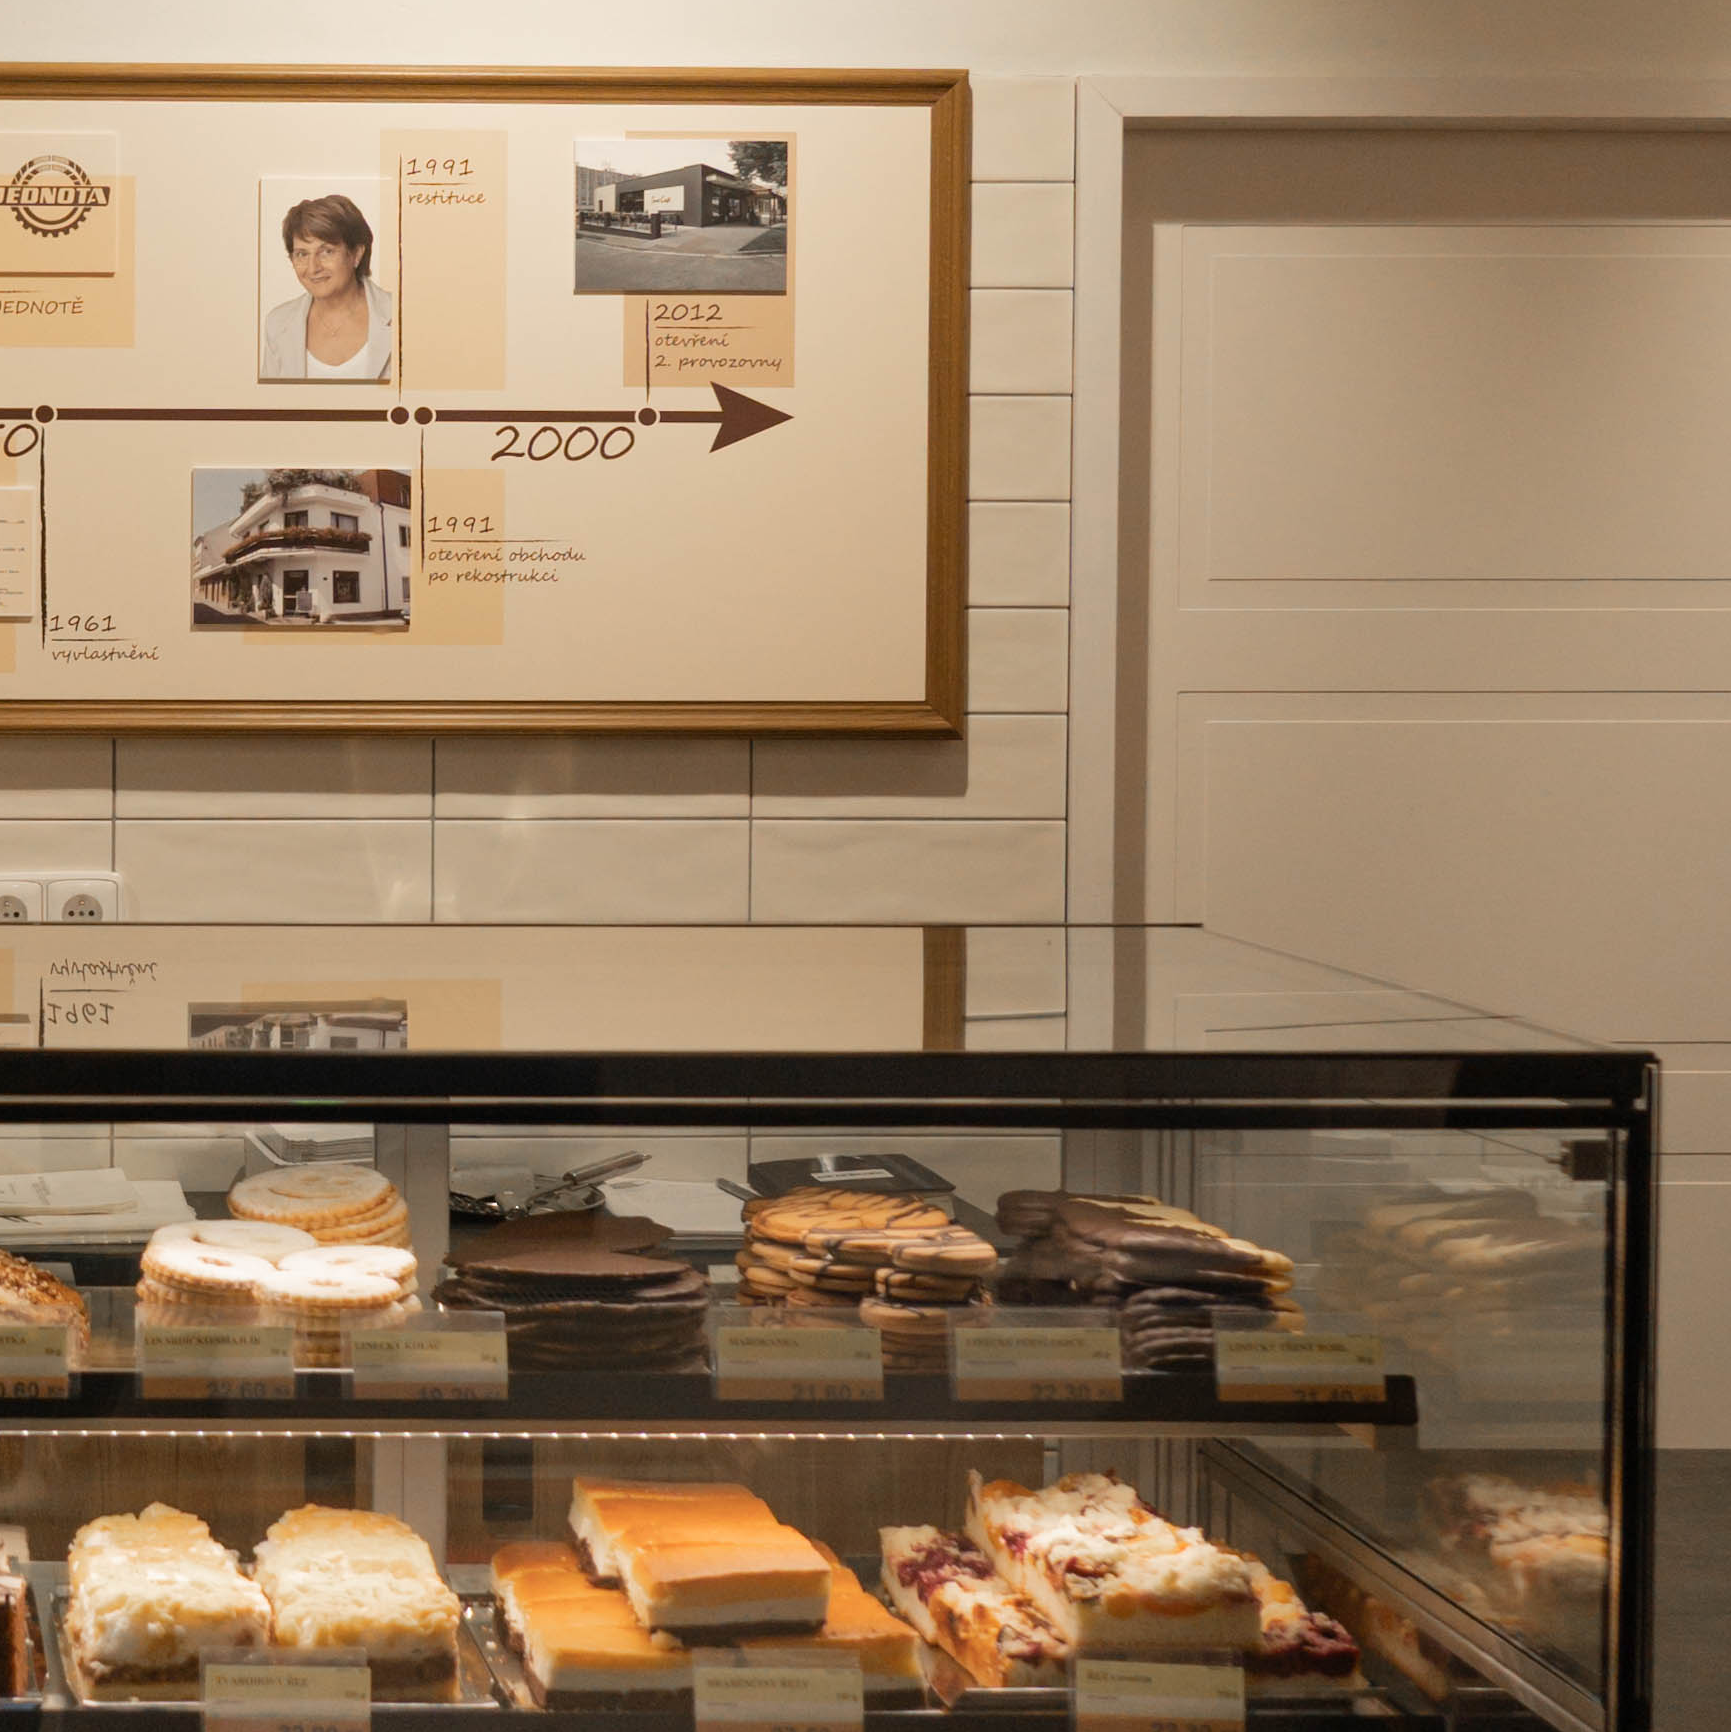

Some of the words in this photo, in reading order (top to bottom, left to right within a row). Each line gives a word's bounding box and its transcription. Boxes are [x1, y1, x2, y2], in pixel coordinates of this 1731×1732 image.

[406, 158, 474, 176] 1991
[408, 189, 487, 205] restituce
[653, 303, 723, 322] 2012
[655, 333, 730, 348] otevření
[654, 355, 671, 368] 2.
[678, 356, 782, 372] provozovny
[491, 425, 635, 461] 2000
[427, 516, 495, 534] 1991
[428, 547, 502, 562] otevření
[508, 547, 586, 562] obchodu
[428, 572, 449, 586] po
[456, 568, 559, 583] rekostrukci
[49, 614, 116, 632] 1961
[52, 644, 160, 664] vyvlastnění
